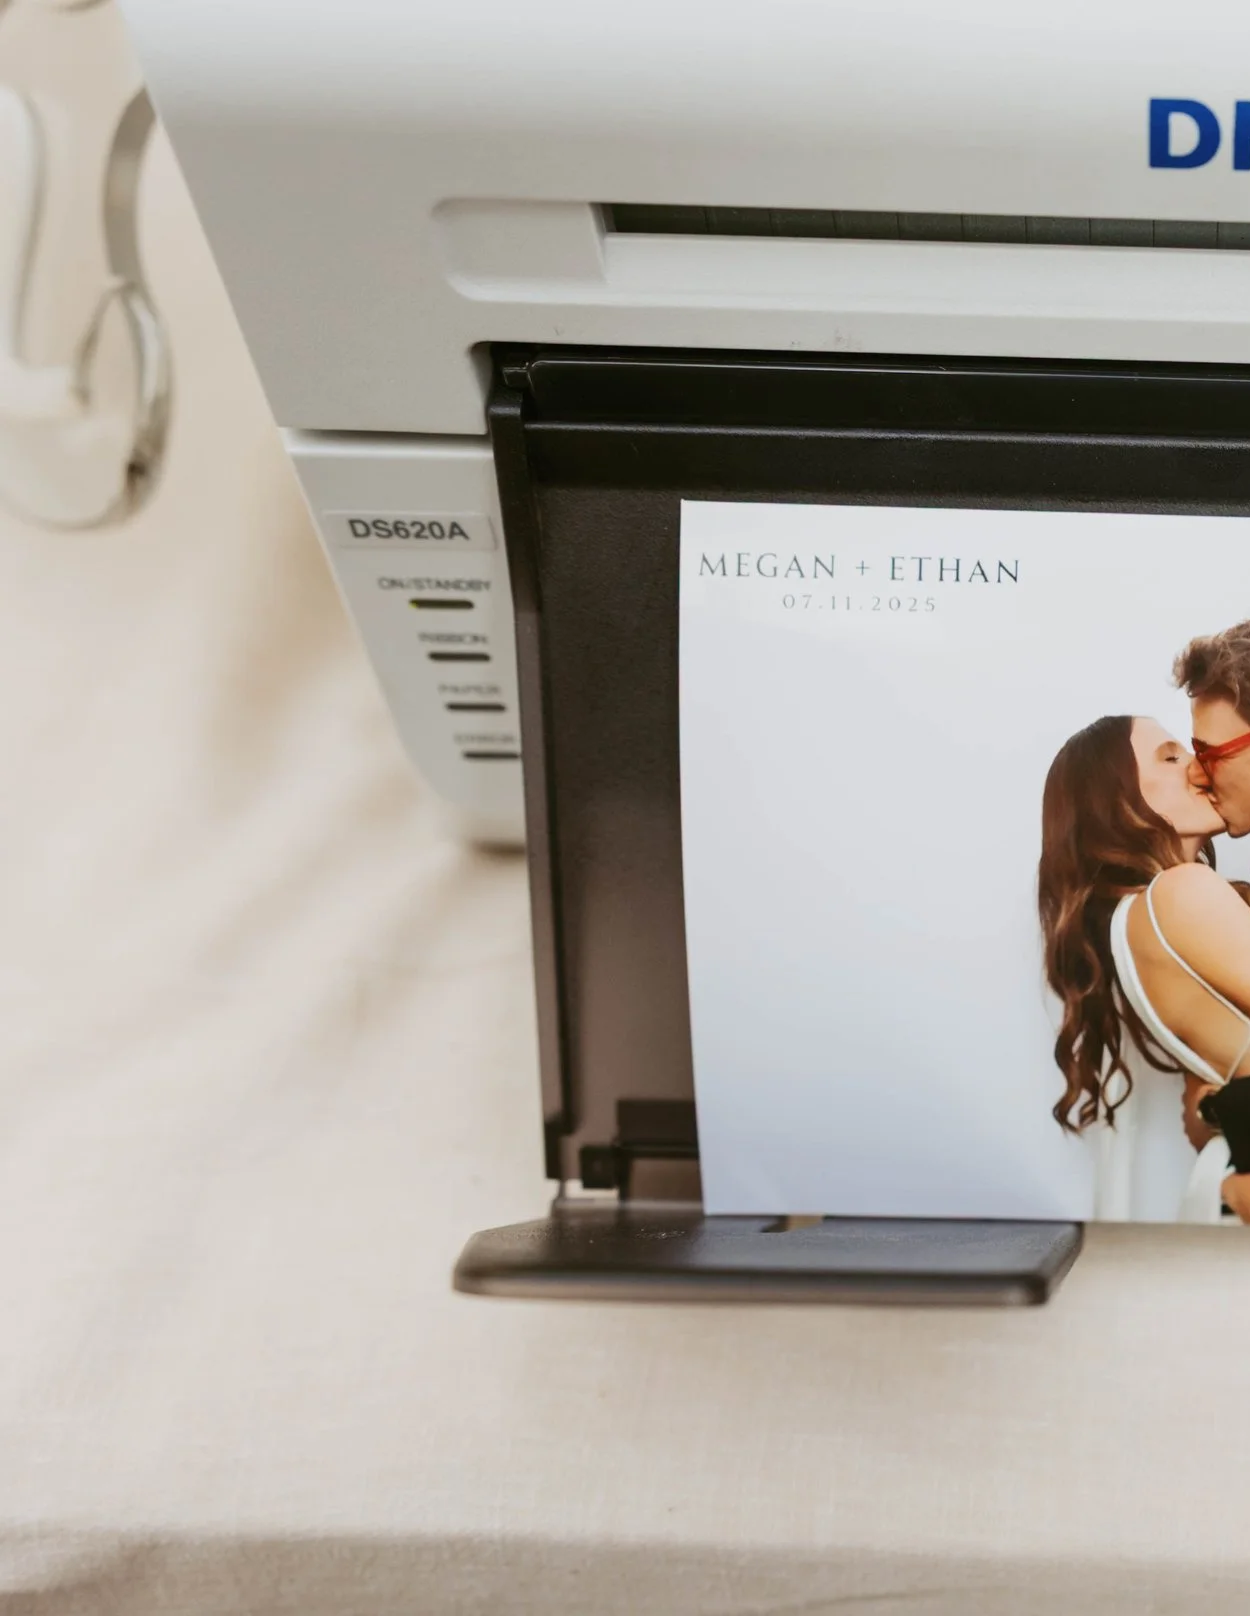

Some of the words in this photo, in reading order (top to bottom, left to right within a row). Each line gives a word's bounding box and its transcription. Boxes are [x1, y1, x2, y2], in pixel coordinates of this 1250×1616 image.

[348, 518, 470, 541] DS620A
[698, 551, 836, 579] MEGAN
[855, 559, 871, 577] +
[889, 555, 1020, 584] ETHAN
[377, 576, 491, 592] ON/STANDBY
[782, 593, 937, 612] 07.11.2025
